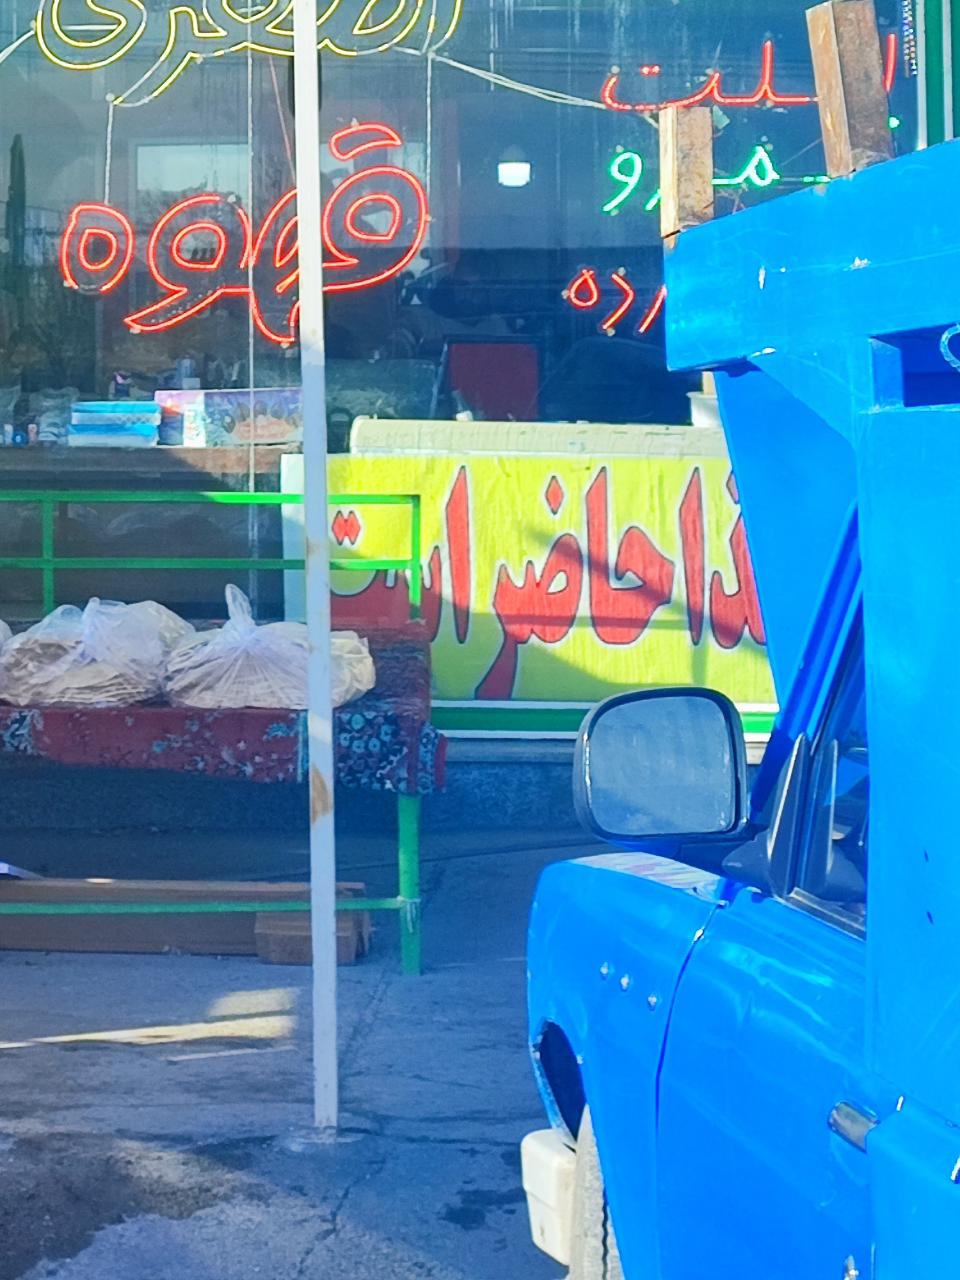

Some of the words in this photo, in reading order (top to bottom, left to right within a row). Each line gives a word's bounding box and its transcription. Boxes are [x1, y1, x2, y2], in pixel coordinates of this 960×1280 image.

[599, 31, 899, 113] الت
[60, 122, 432, 345] قهوه
[475, 465, 675, 700] حاضر
[679, 465, 767, 649] ذا
